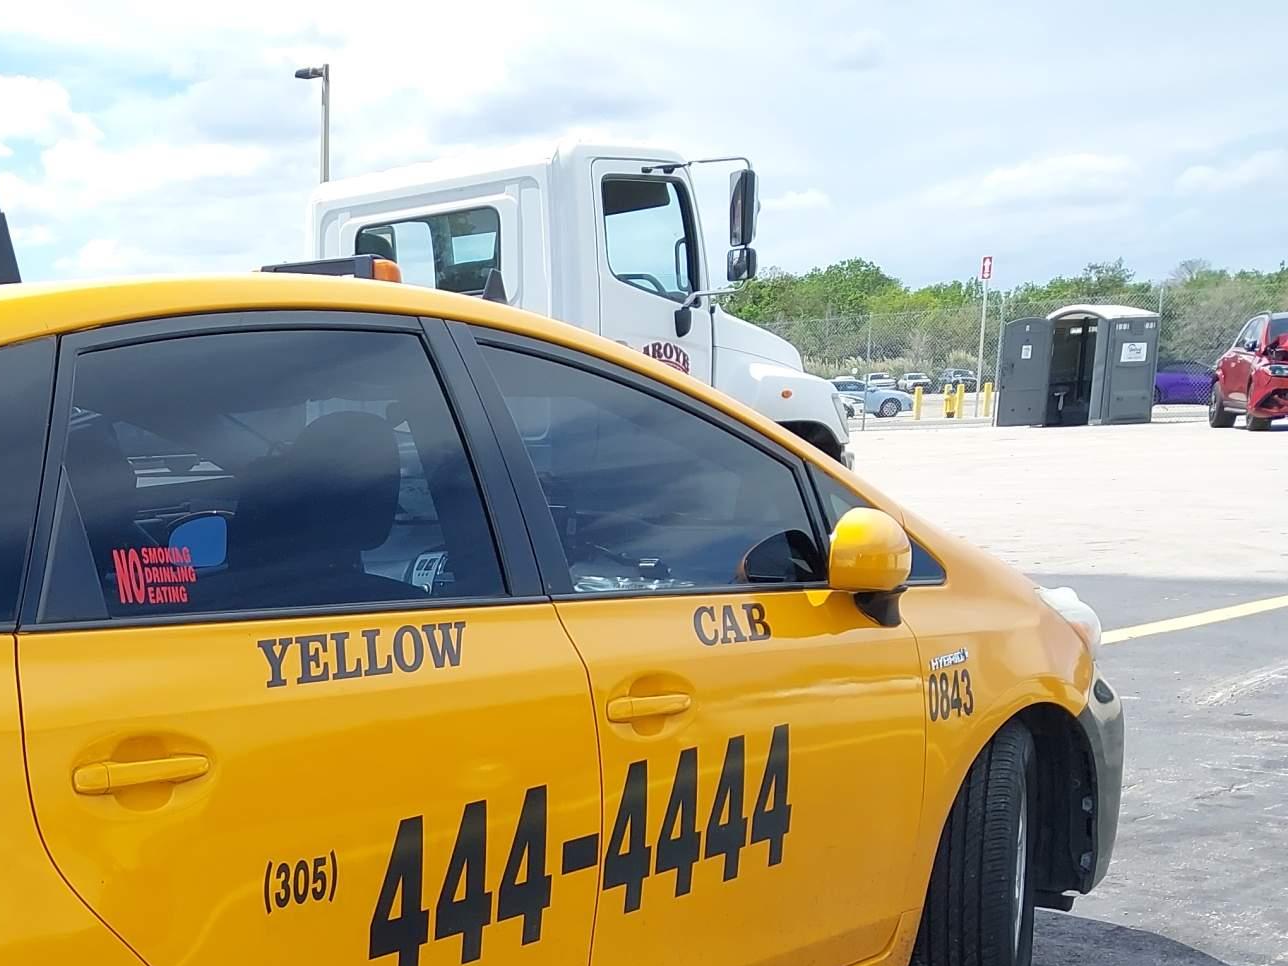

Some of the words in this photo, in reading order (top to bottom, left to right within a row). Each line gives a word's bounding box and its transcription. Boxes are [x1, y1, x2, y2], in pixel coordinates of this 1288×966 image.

[112, 548, 145, 604] NO
[141, 546, 191, 564] SMOKING
[144, 566, 197, 583] DRINKING
[147, 586, 188, 603] EATING
[257, 621, 467, 688] YELLOW
[693, 602, 772, 646] CAB
[928, 668, 974, 722] 0843
[264, 849, 338, 915] (305)
